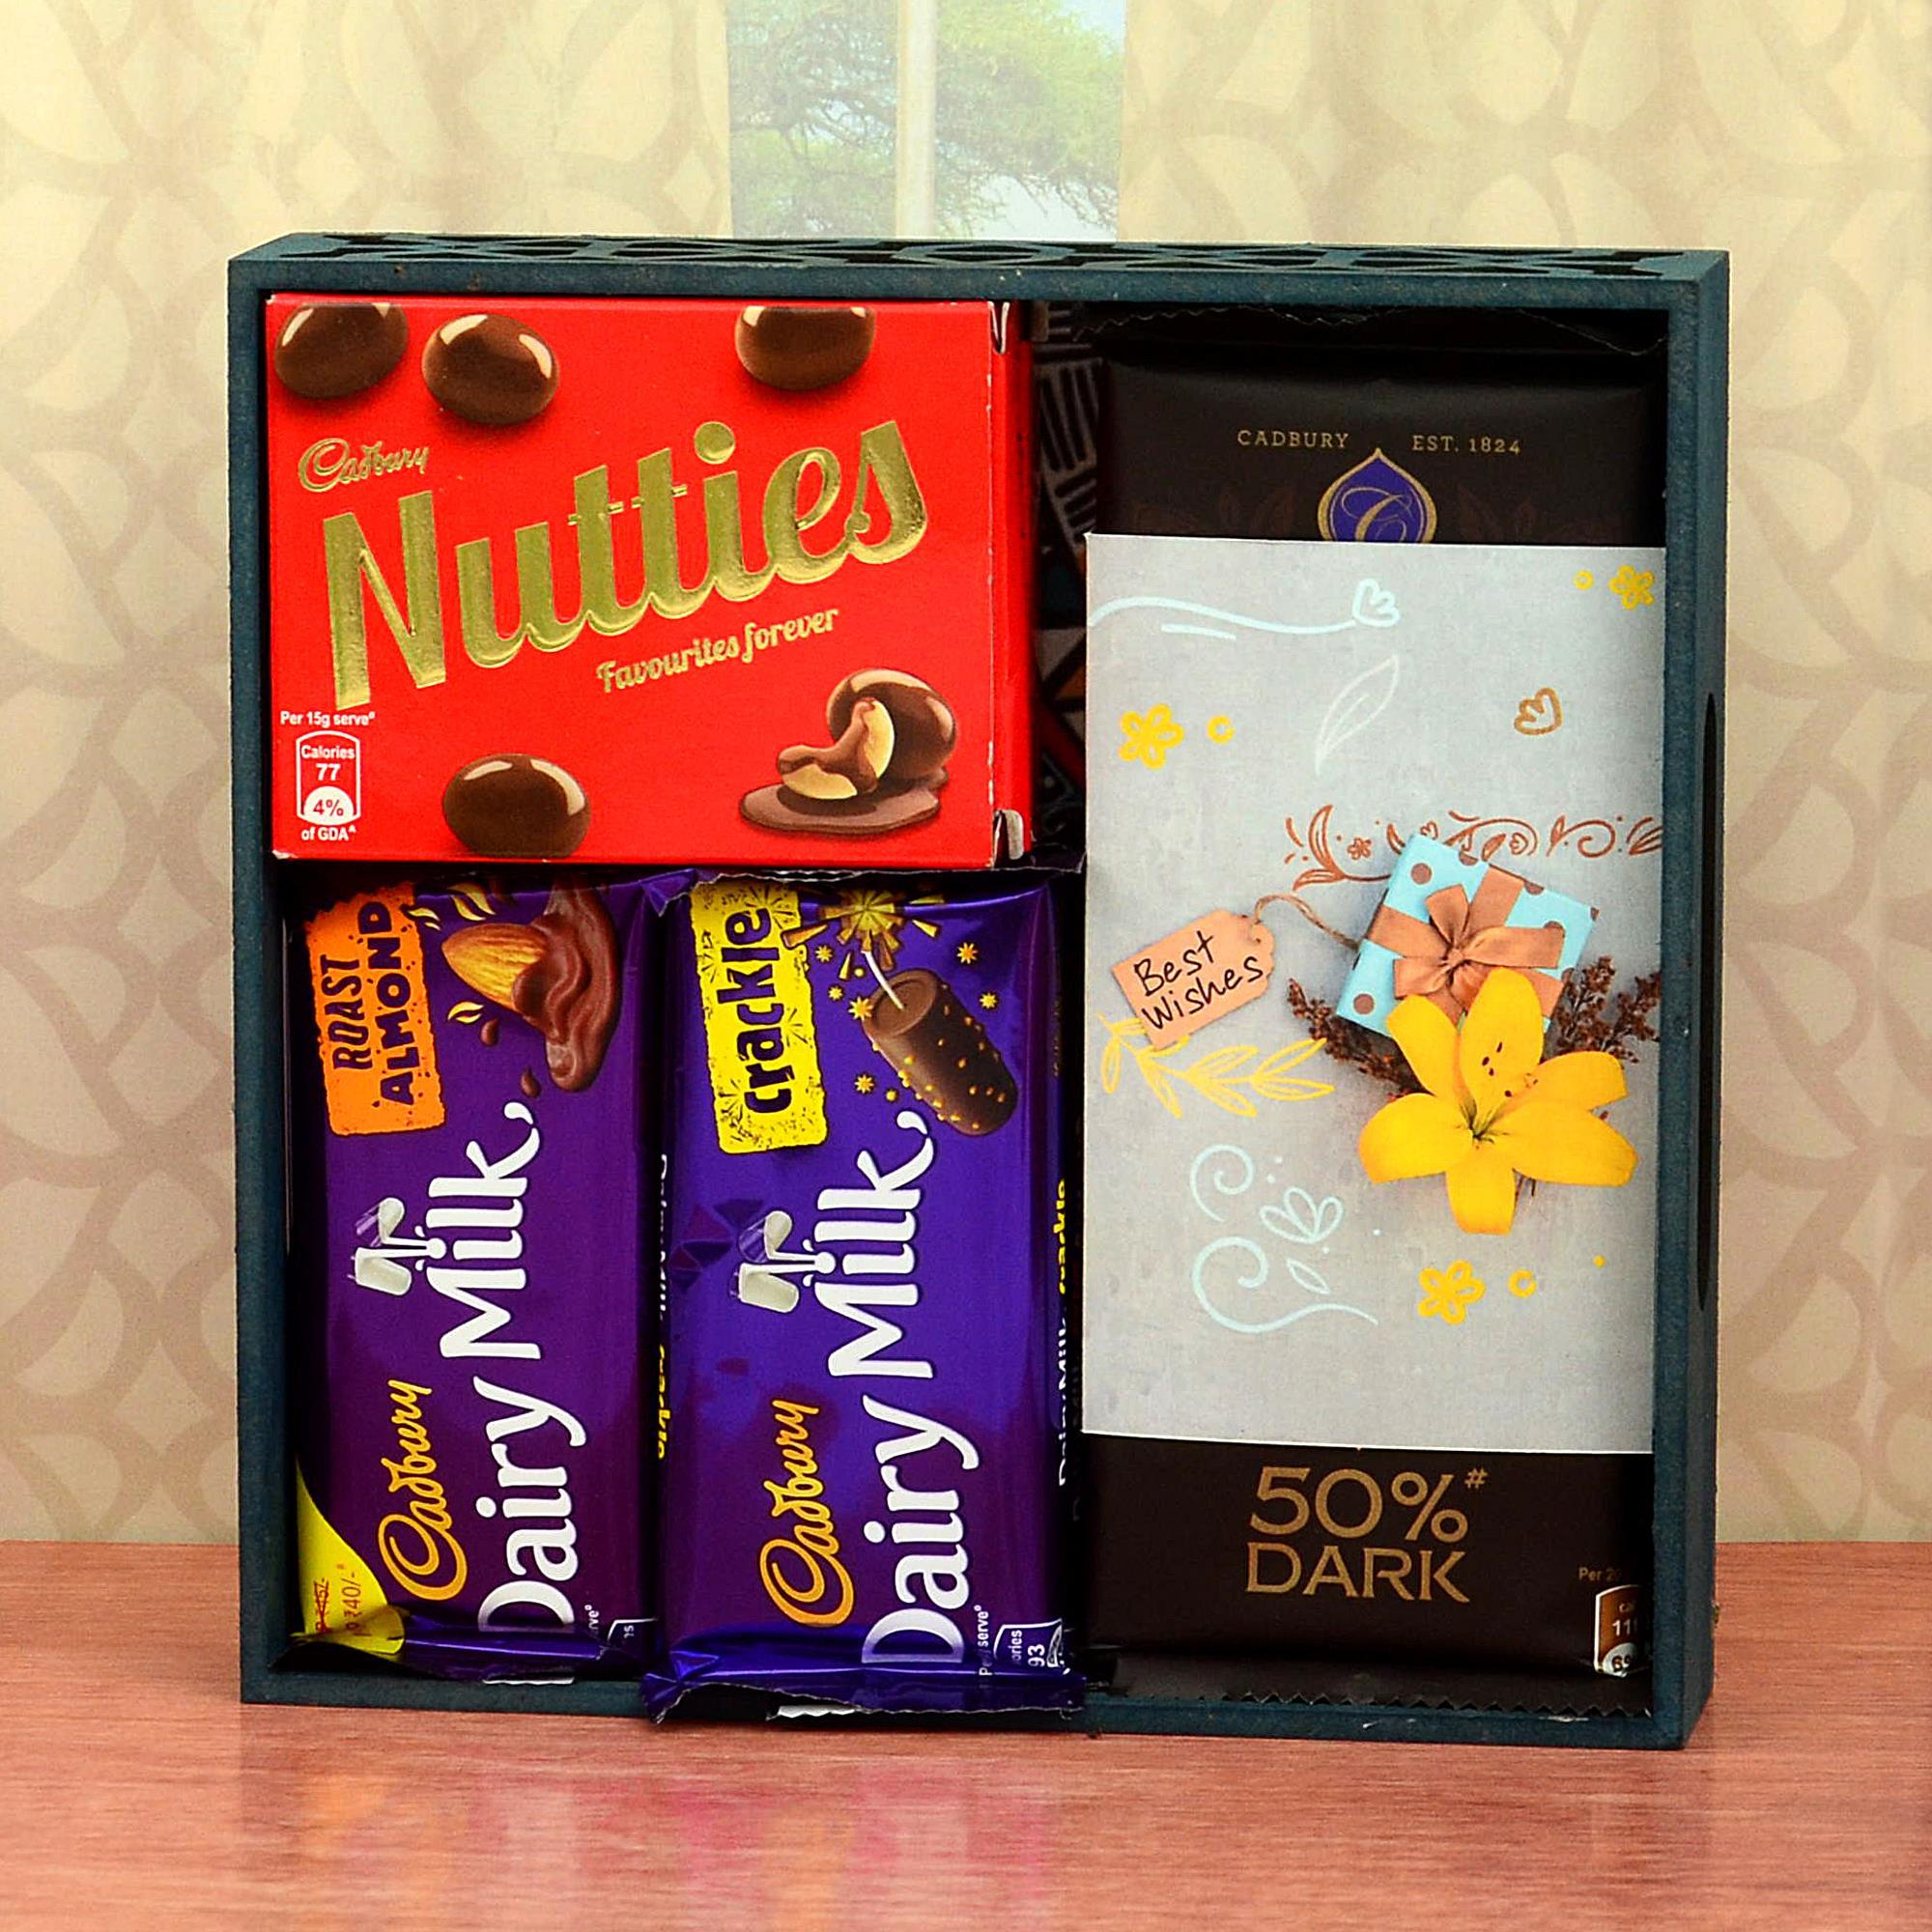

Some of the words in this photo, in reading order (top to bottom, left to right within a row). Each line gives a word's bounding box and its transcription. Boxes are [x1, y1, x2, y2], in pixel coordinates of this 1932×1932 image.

[297, 437, 431, 495] Cadbury
[1236, 429, 1350, 449] CADBURY
[1411, 434, 1460, 452] EST.
[1467, 435, 1521, 456] 1824
[323, 420, 929, 711] Nutties
[596, 636, 740, 694] Favourites
[740, 607, 839, 664] forever
[279, 710, 303, 725] Per
[306, 711, 330, 728] 15g
[300, 744, 356, 759] Calories
[312, 798, 345, 817] 4%
[315, 762, 342, 781] 77
[300, 826, 316, 841] of
[1133, 929, 1217, 998] Best
[1142, 954, 1264, 1030] Wishes
[320, 953, 373, 1070] ROAST
[358, 900, 418, 1106] ALMOND
[716, 906, 792, 1115] crackle
[426, 1100, 542, 1360] Milk
[813, 1110, 935, 1379] Milk
[377, 1378, 469, 1602] Cadbury
[472, 1375, 587, 1634] Dairy
[758, 1399, 855, 1627] Cadbury
[861, 1394, 980, 1664] Dairy
[1245, 1541, 1470, 1604] DARK
[1577, 1566, 1603, 1581] Per
[1027, 1643, 1045, 1667] 93
